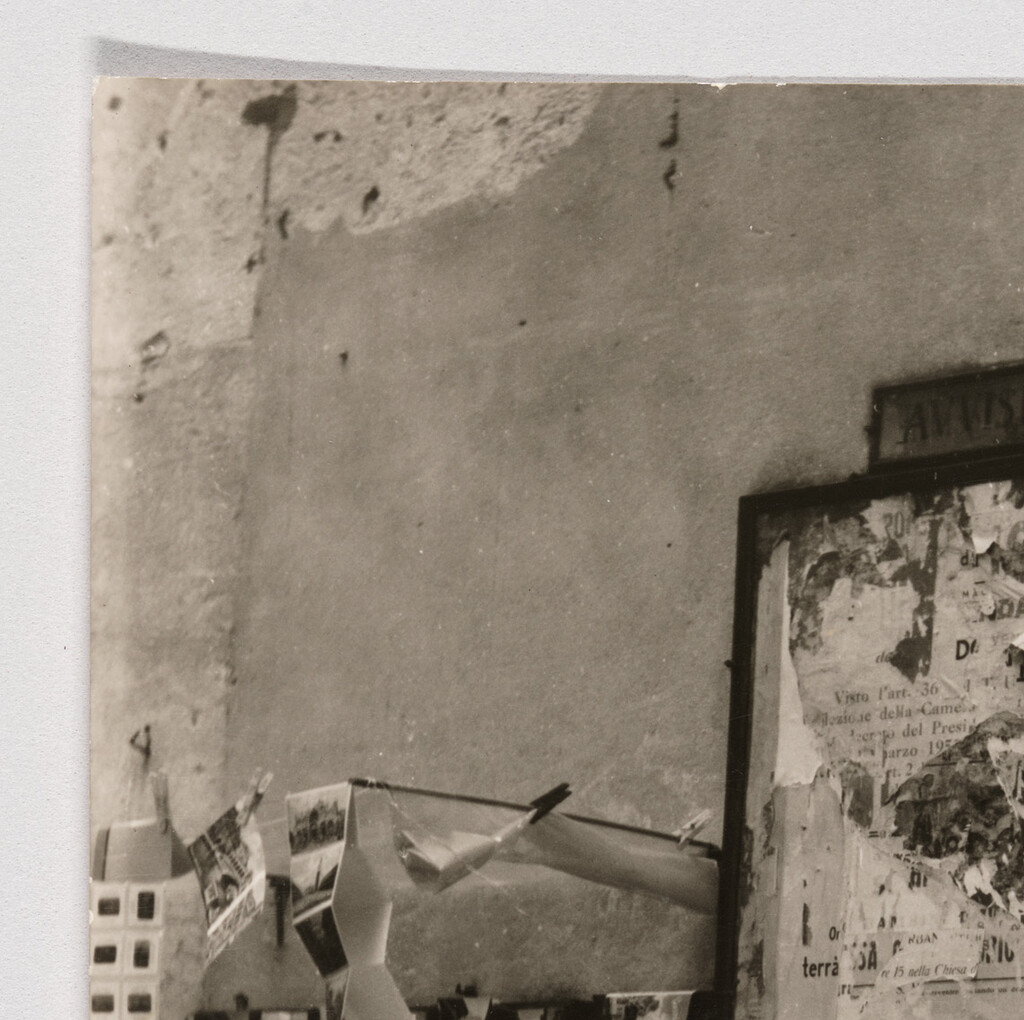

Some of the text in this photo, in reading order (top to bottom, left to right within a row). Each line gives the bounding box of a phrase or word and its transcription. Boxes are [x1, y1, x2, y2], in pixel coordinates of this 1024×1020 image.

[920, 682, 938, 698] 36
[880, 704, 912, 721] della
[901, 722, 923, 738] del
[802, 955, 840, 978] terrà
[908, 965, 932, 978] nella
[934, 963, 968, 978] Chiesa
